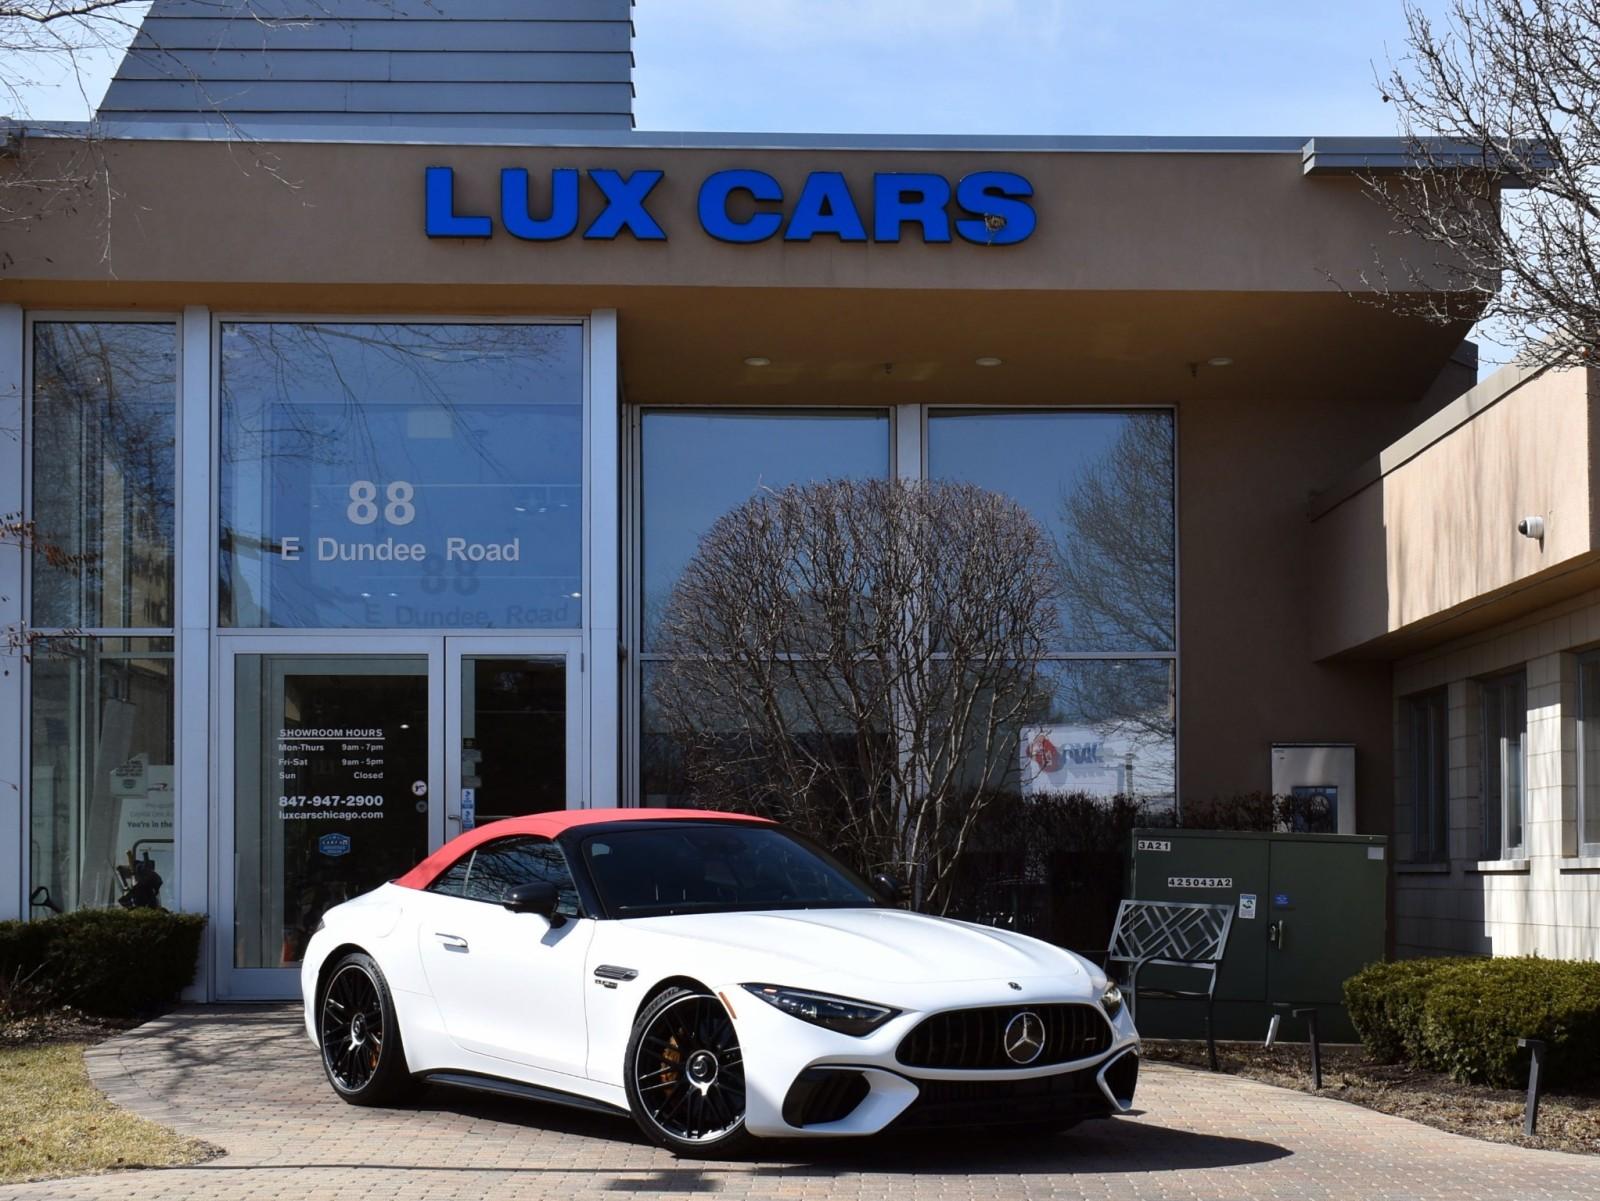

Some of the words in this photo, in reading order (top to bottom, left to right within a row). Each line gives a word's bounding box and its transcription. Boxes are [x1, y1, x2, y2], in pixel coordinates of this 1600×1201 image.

[425, 166, 667, 240] LUX
[697, 169, 1038, 244] CARS
[347, 480, 416, 525] 88
[281, 537, 300, 561] E
[317, 537, 426, 561] Dundee
[446, 537, 520, 561] Road
[279, 728, 343, 737] SHOWROOM
[345, 728, 383, 737] HOURS
[278, 743, 325, 751] Mon-Thurs
[341, 743, 360, 751] 9am
[366, 743, 384, 752] 7pm
[278, 758, 308, 766] Fri-Sat
[341, 758, 360, 766] 9am
[366, 757, 384, 767] 5pm
[353, 771, 384, 779] Closed
[278, 795, 384, 807] 847-947-2900
[278, 810, 384, 820] luxcarschicago.com
[1138, 841, 1170, 850] 3A21
[1168, 878, 1232, 887] 425043A2
